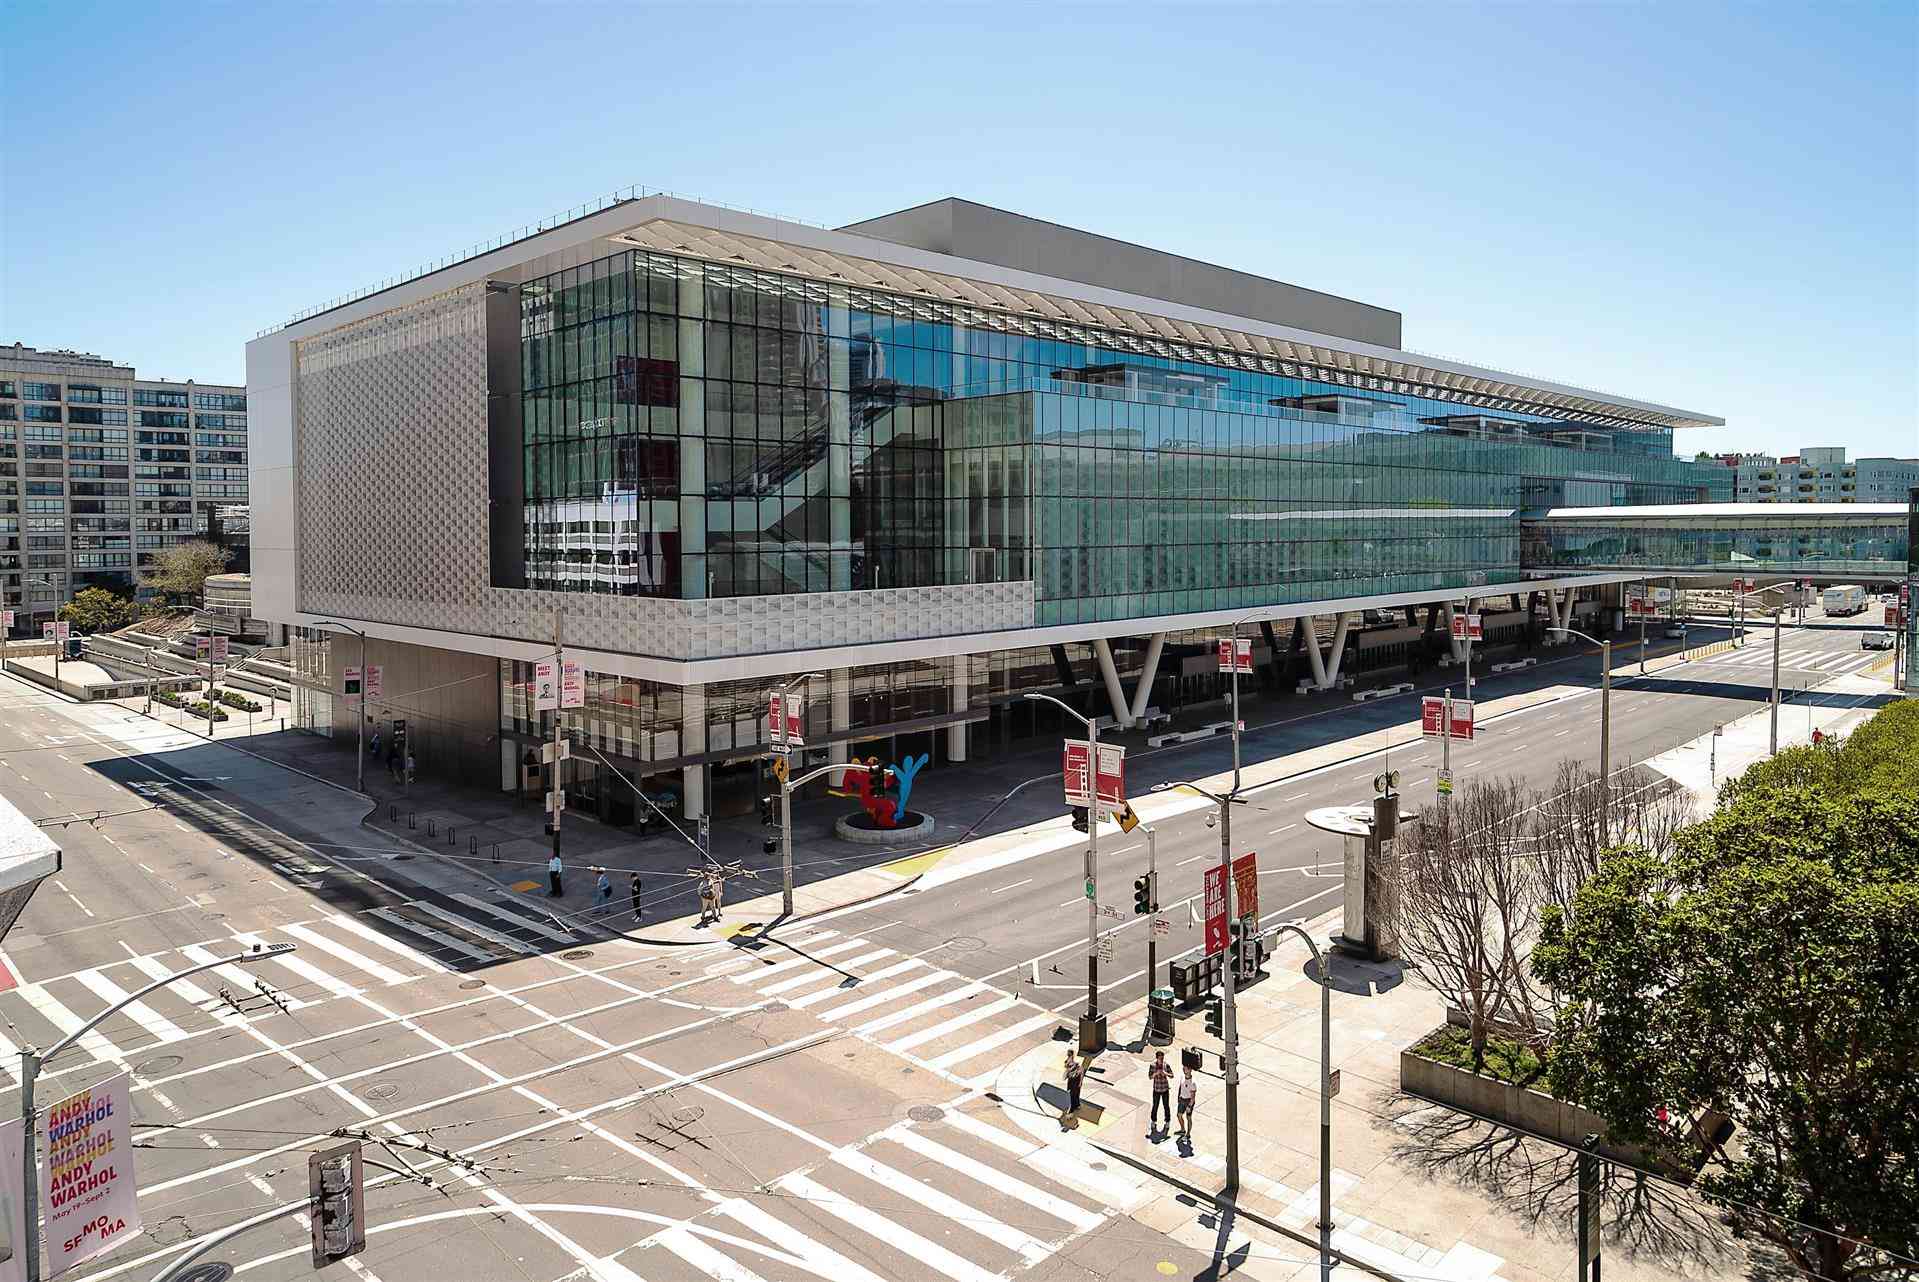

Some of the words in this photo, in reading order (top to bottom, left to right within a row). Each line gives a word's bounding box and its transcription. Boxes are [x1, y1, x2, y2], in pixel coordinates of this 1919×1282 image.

[1210, 870, 1221, 889] WE
[1210, 883, 1222, 904] ARE
[1210, 898, 1225, 920] HERE
[49, 1095, 91, 1128] ANDY
[49, 1103, 113, 1143] WARHOL
[50, 1129, 114, 1170] WARHOL
[51, 1160, 92, 1193] ANDY
[51, 1166, 117, 1208] WARHOL
[53, 1208, 72, 1221] May
